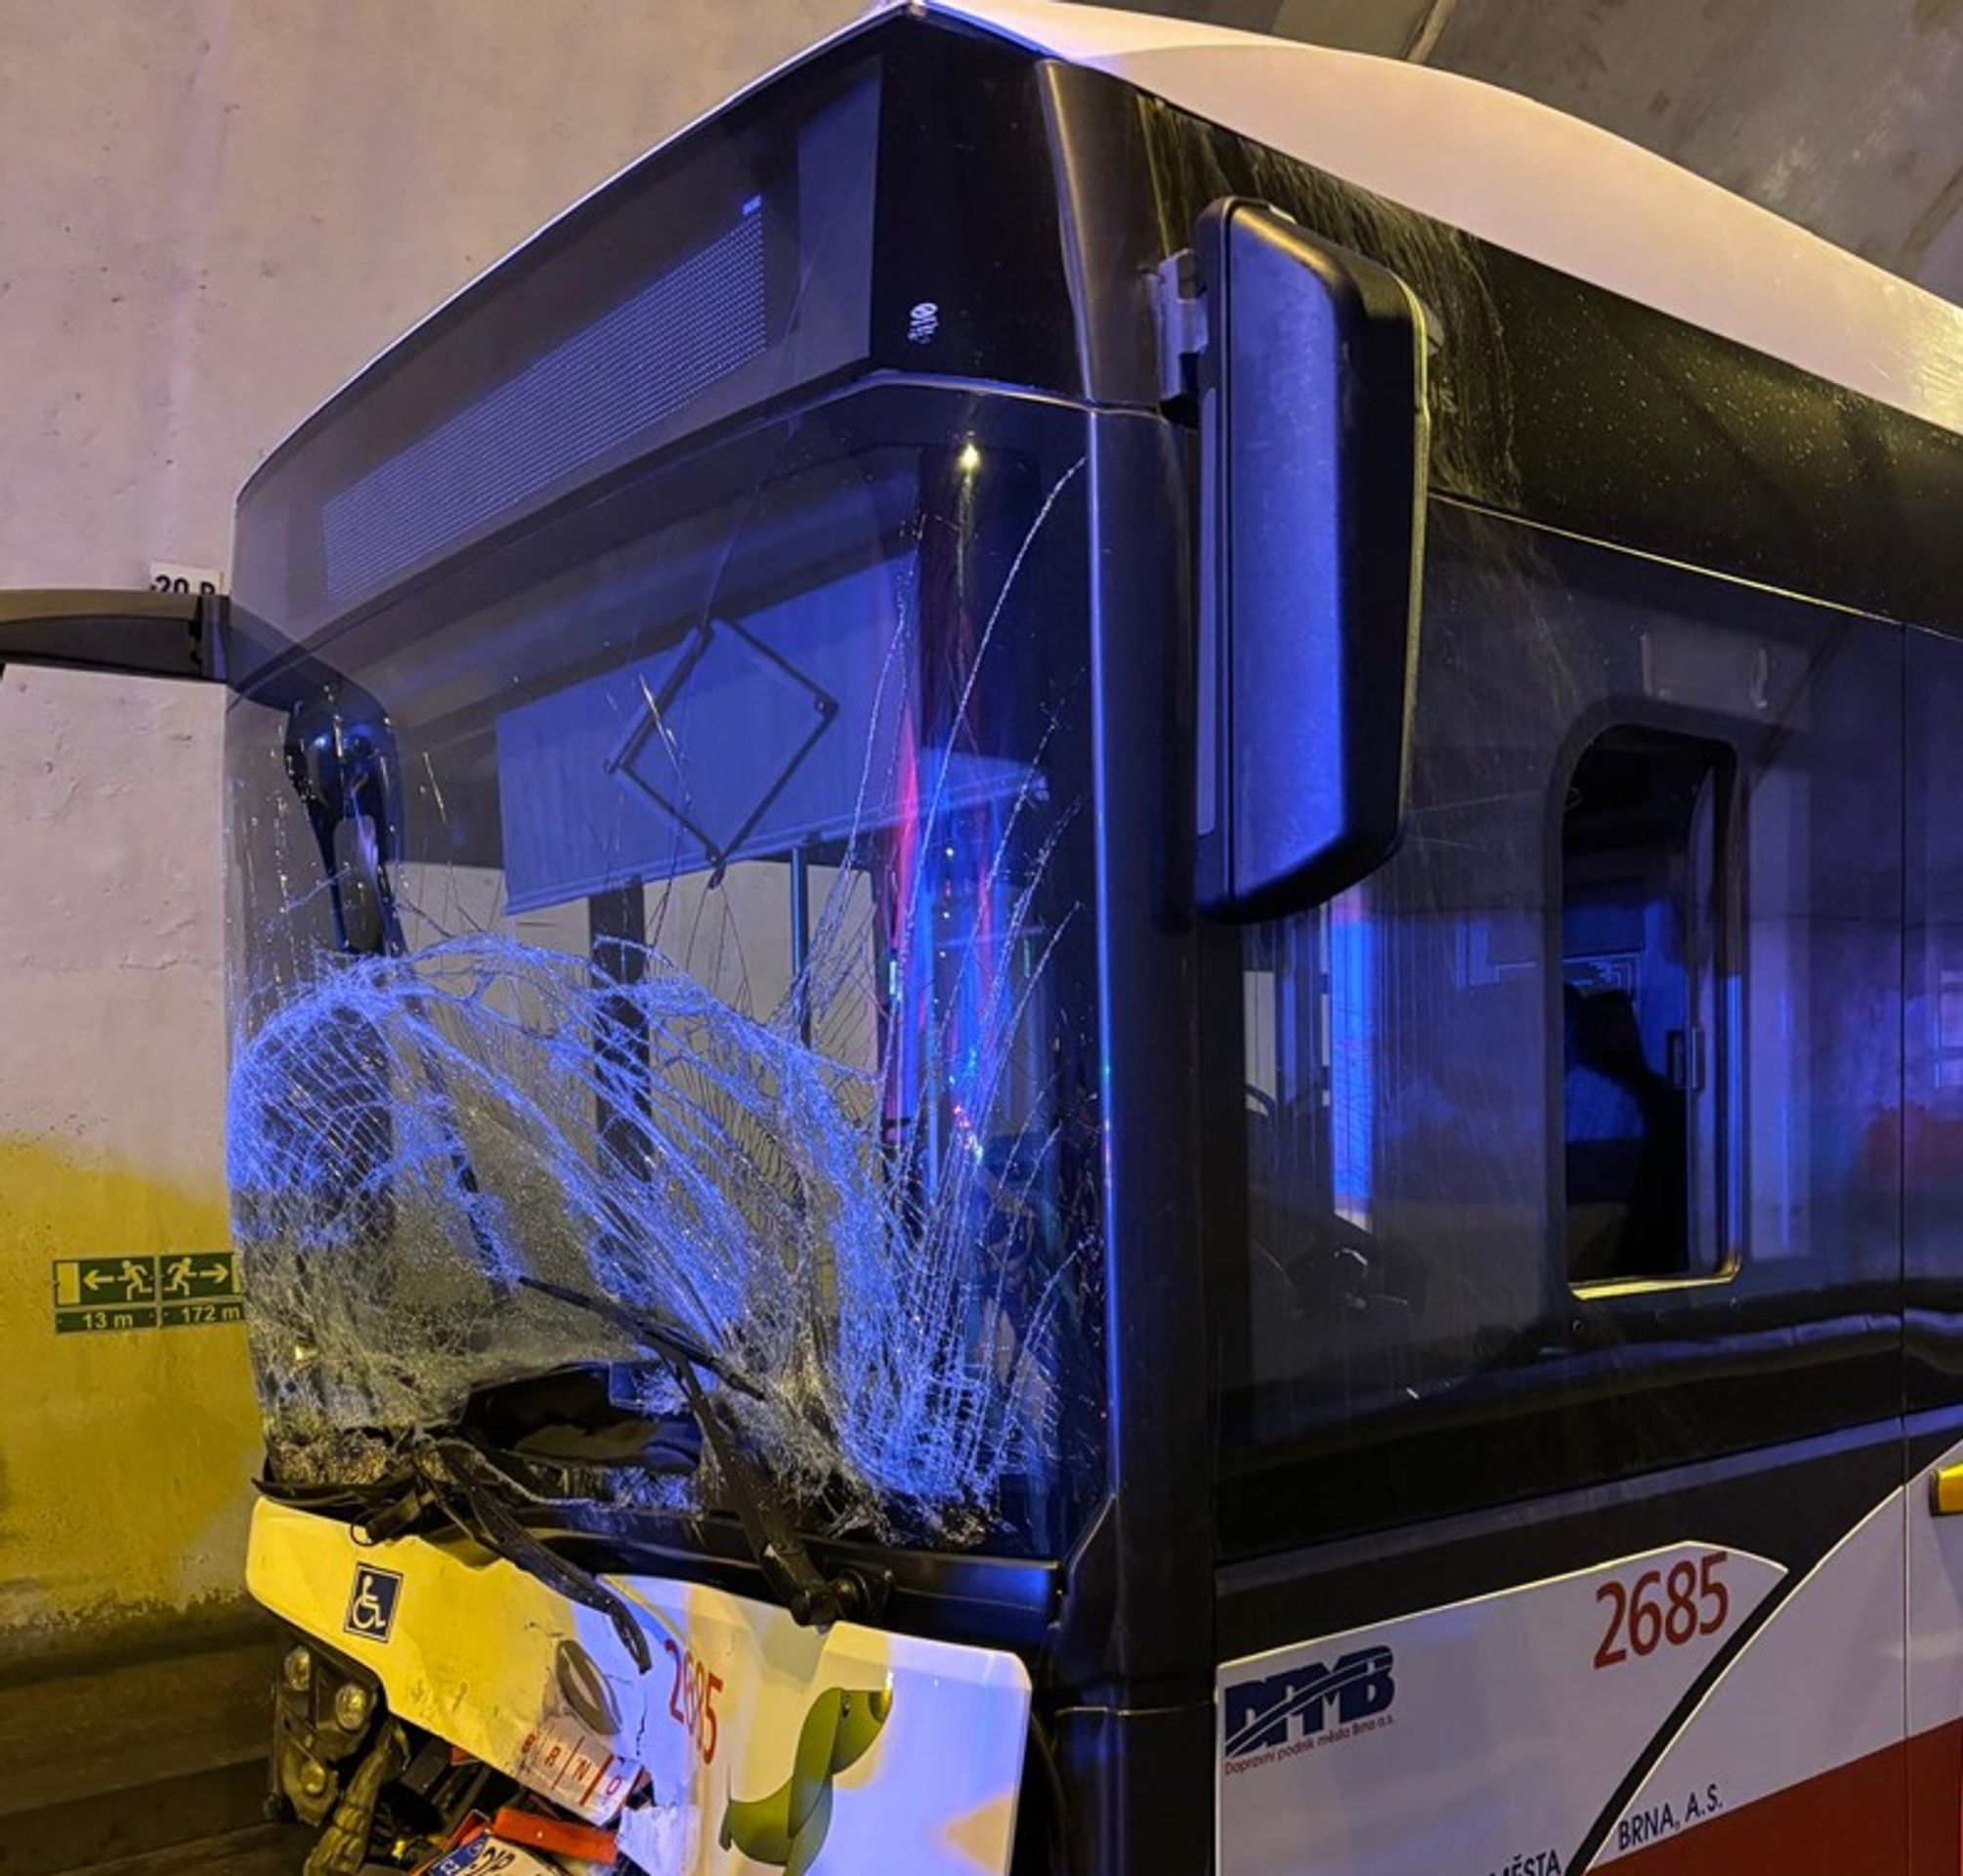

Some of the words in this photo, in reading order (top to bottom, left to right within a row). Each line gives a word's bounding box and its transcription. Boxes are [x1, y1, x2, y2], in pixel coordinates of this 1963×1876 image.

[83, 1313, 107, 1329] 13
[114, 1314, 133, 1328] m
[181, 1304, 215, 1323] 172
[222, 1305, 240, 1320] m
[1594, 1551, 1728, 1669] 2685
[663, 1638, 723, 1766] 2685
[1224, 1644, 1395, 1758] DPMB
[1619, 1803, 1680, 1850] BRNA,
[1686, 1783, 1724, 1821] A.S.
